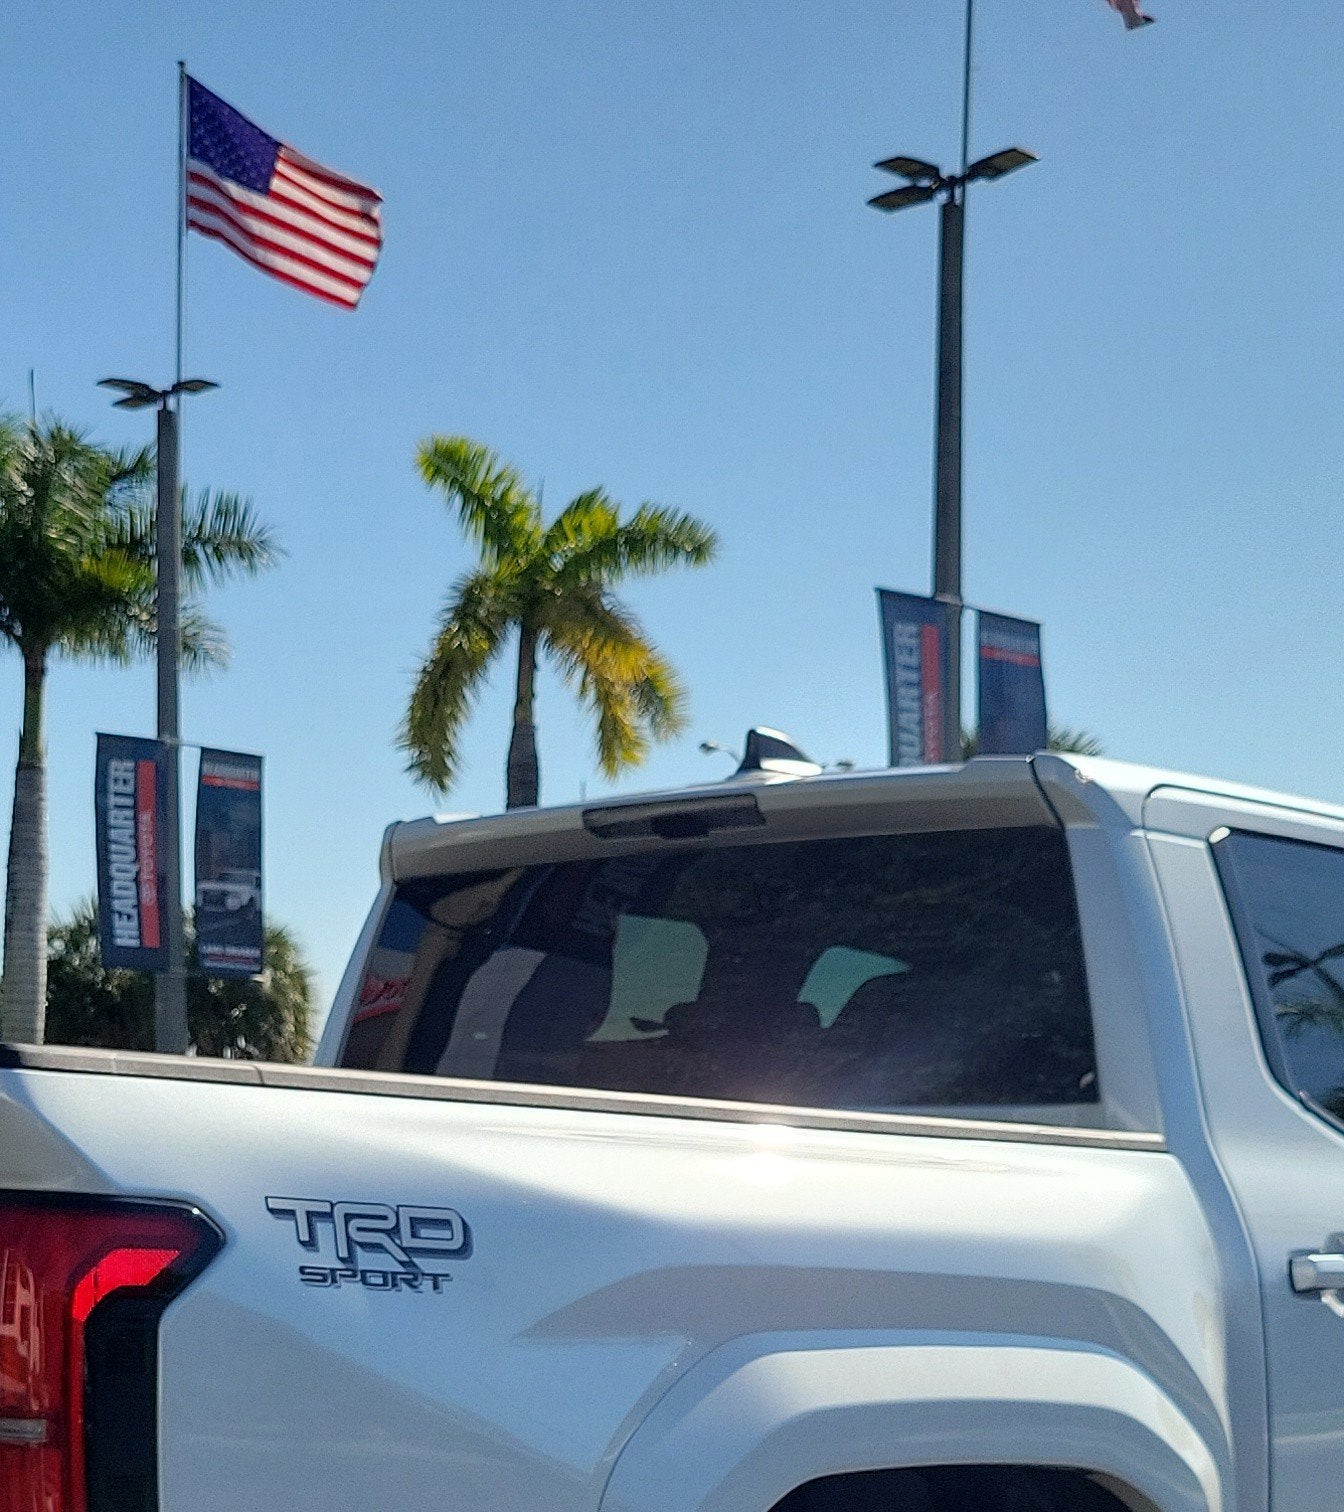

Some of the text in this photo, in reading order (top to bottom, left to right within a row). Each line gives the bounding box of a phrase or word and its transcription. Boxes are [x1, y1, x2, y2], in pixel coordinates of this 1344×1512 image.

[110, 761, 140, 948] HEADQUARTER
[265, 1196, 471, 1264] TRD
[299, 1265, 453, 1294] SPORT
